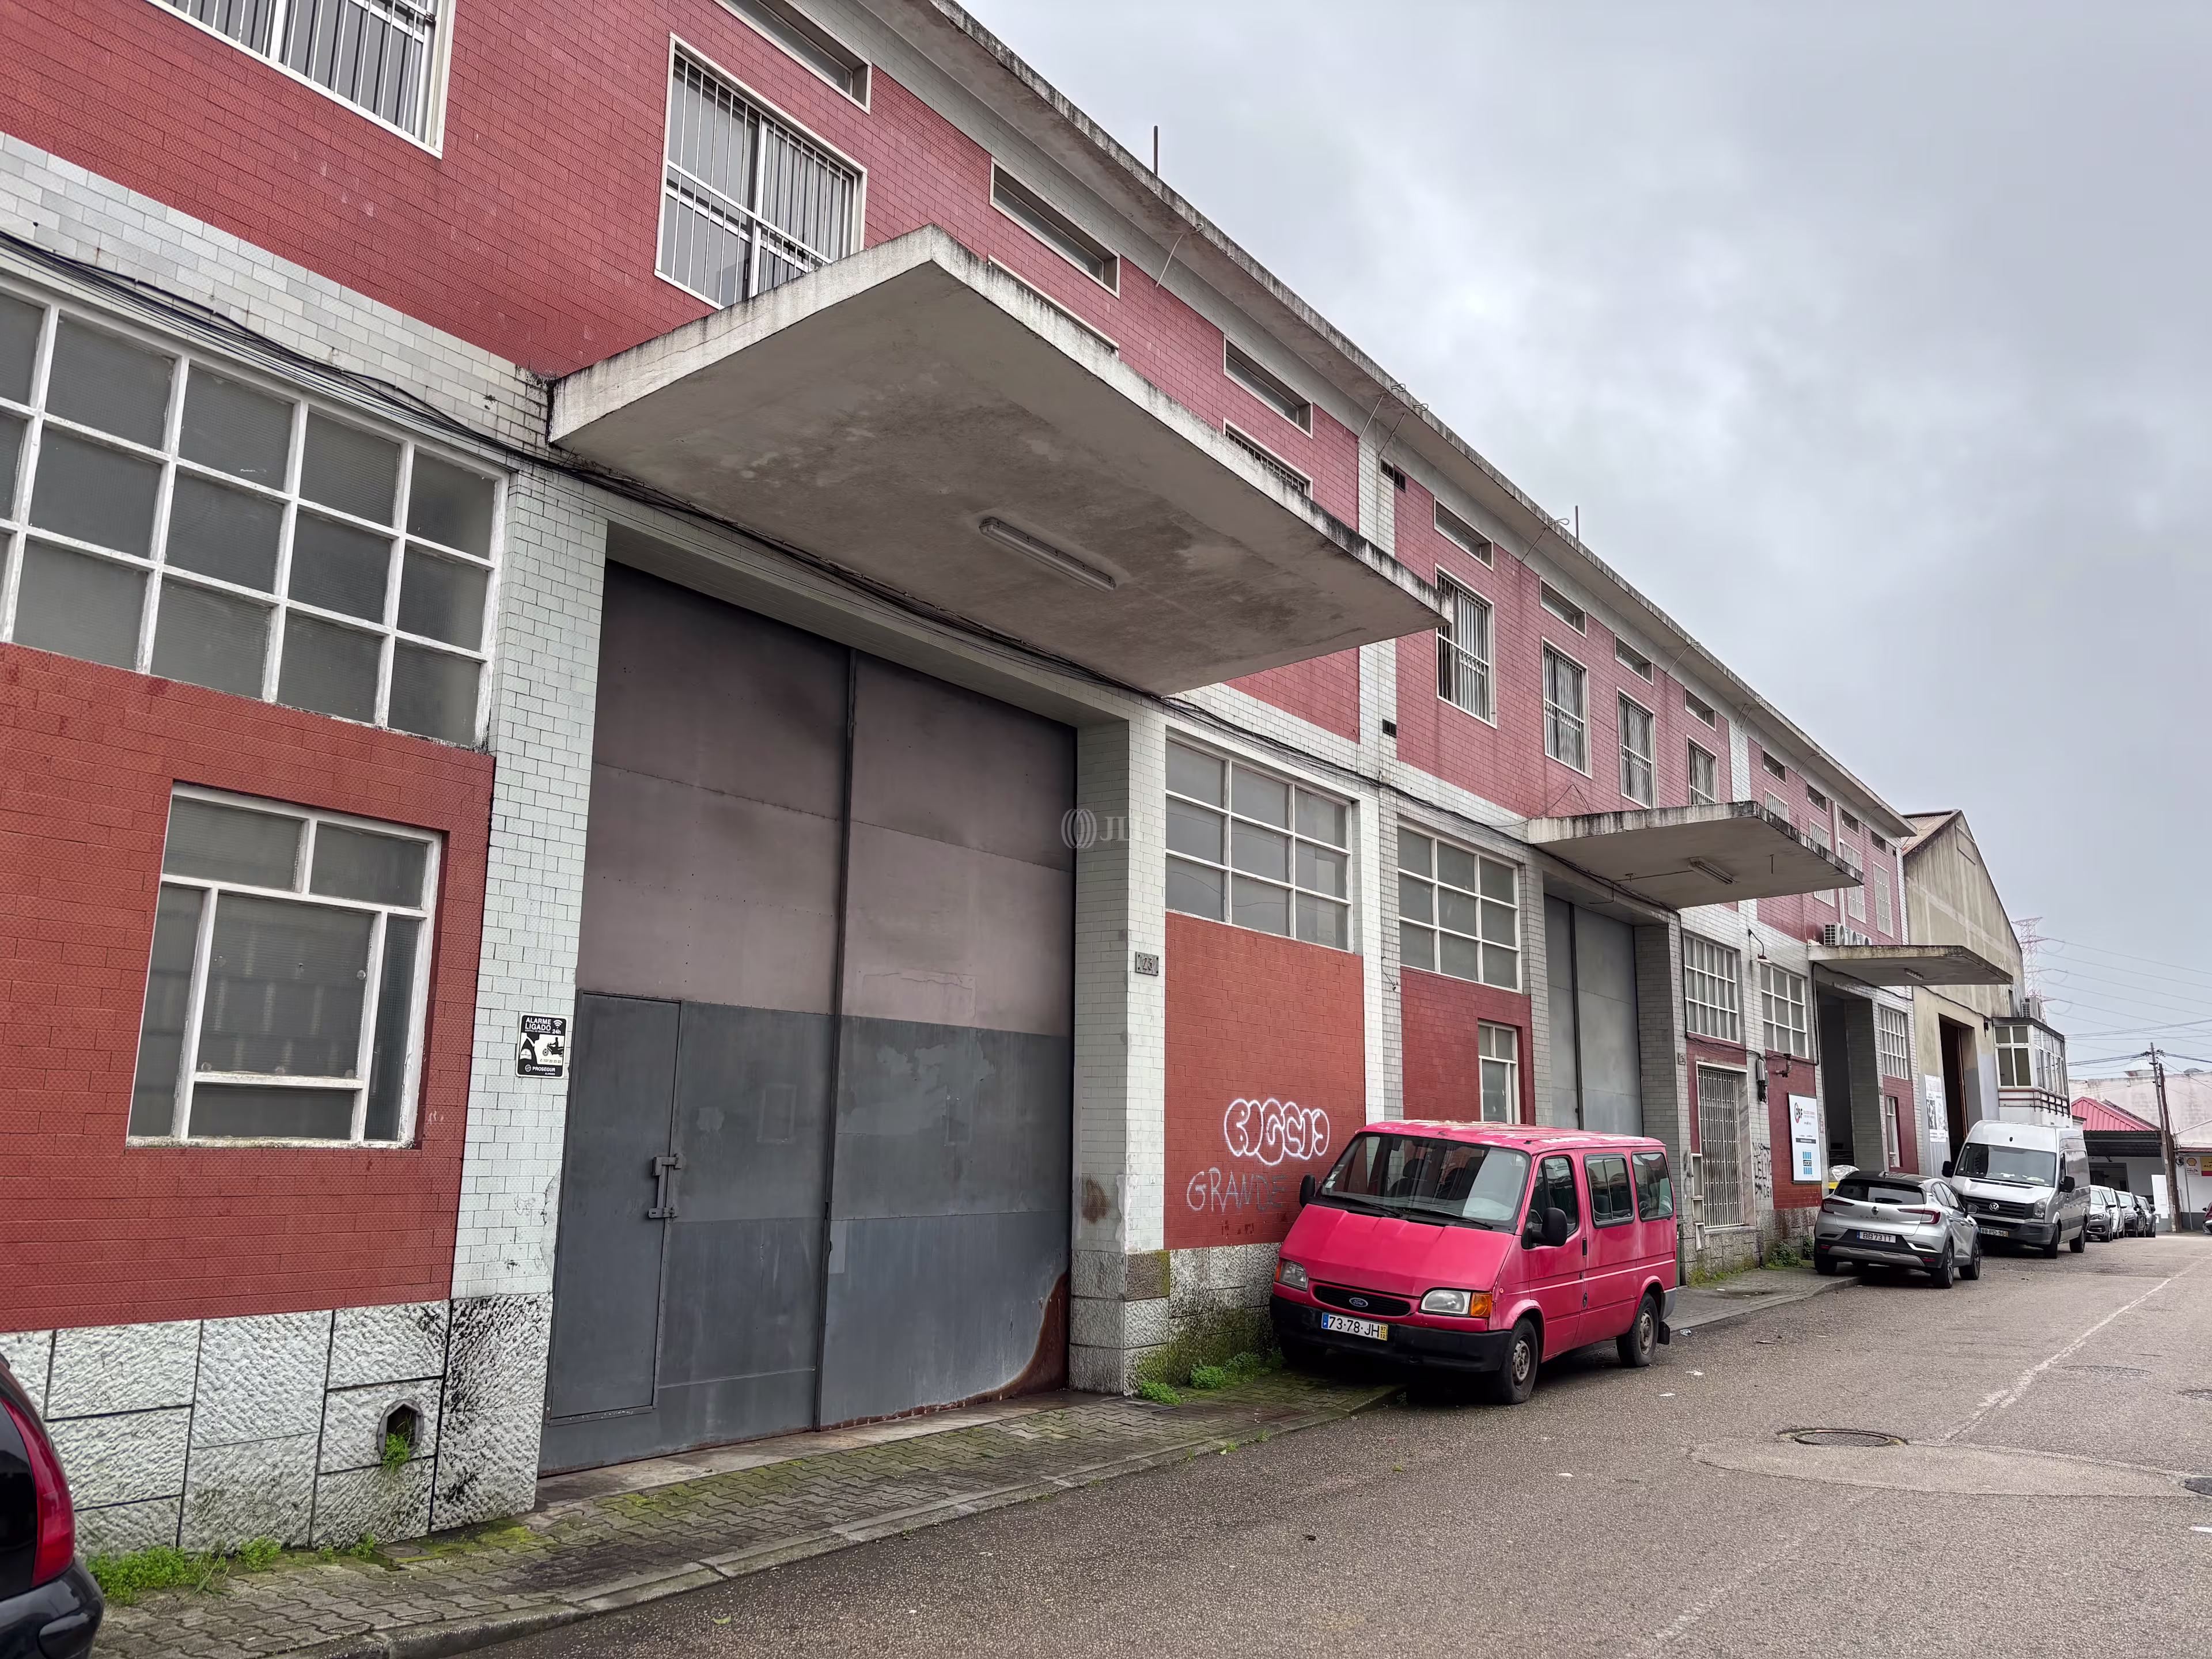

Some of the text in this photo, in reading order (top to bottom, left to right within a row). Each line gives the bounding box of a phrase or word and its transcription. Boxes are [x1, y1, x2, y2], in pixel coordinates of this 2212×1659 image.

[1142, 956, 1153, 971] 23
[526, 1017, 551, 1025] ALARME
[525, 1022, 551, 1031] LIGADO
